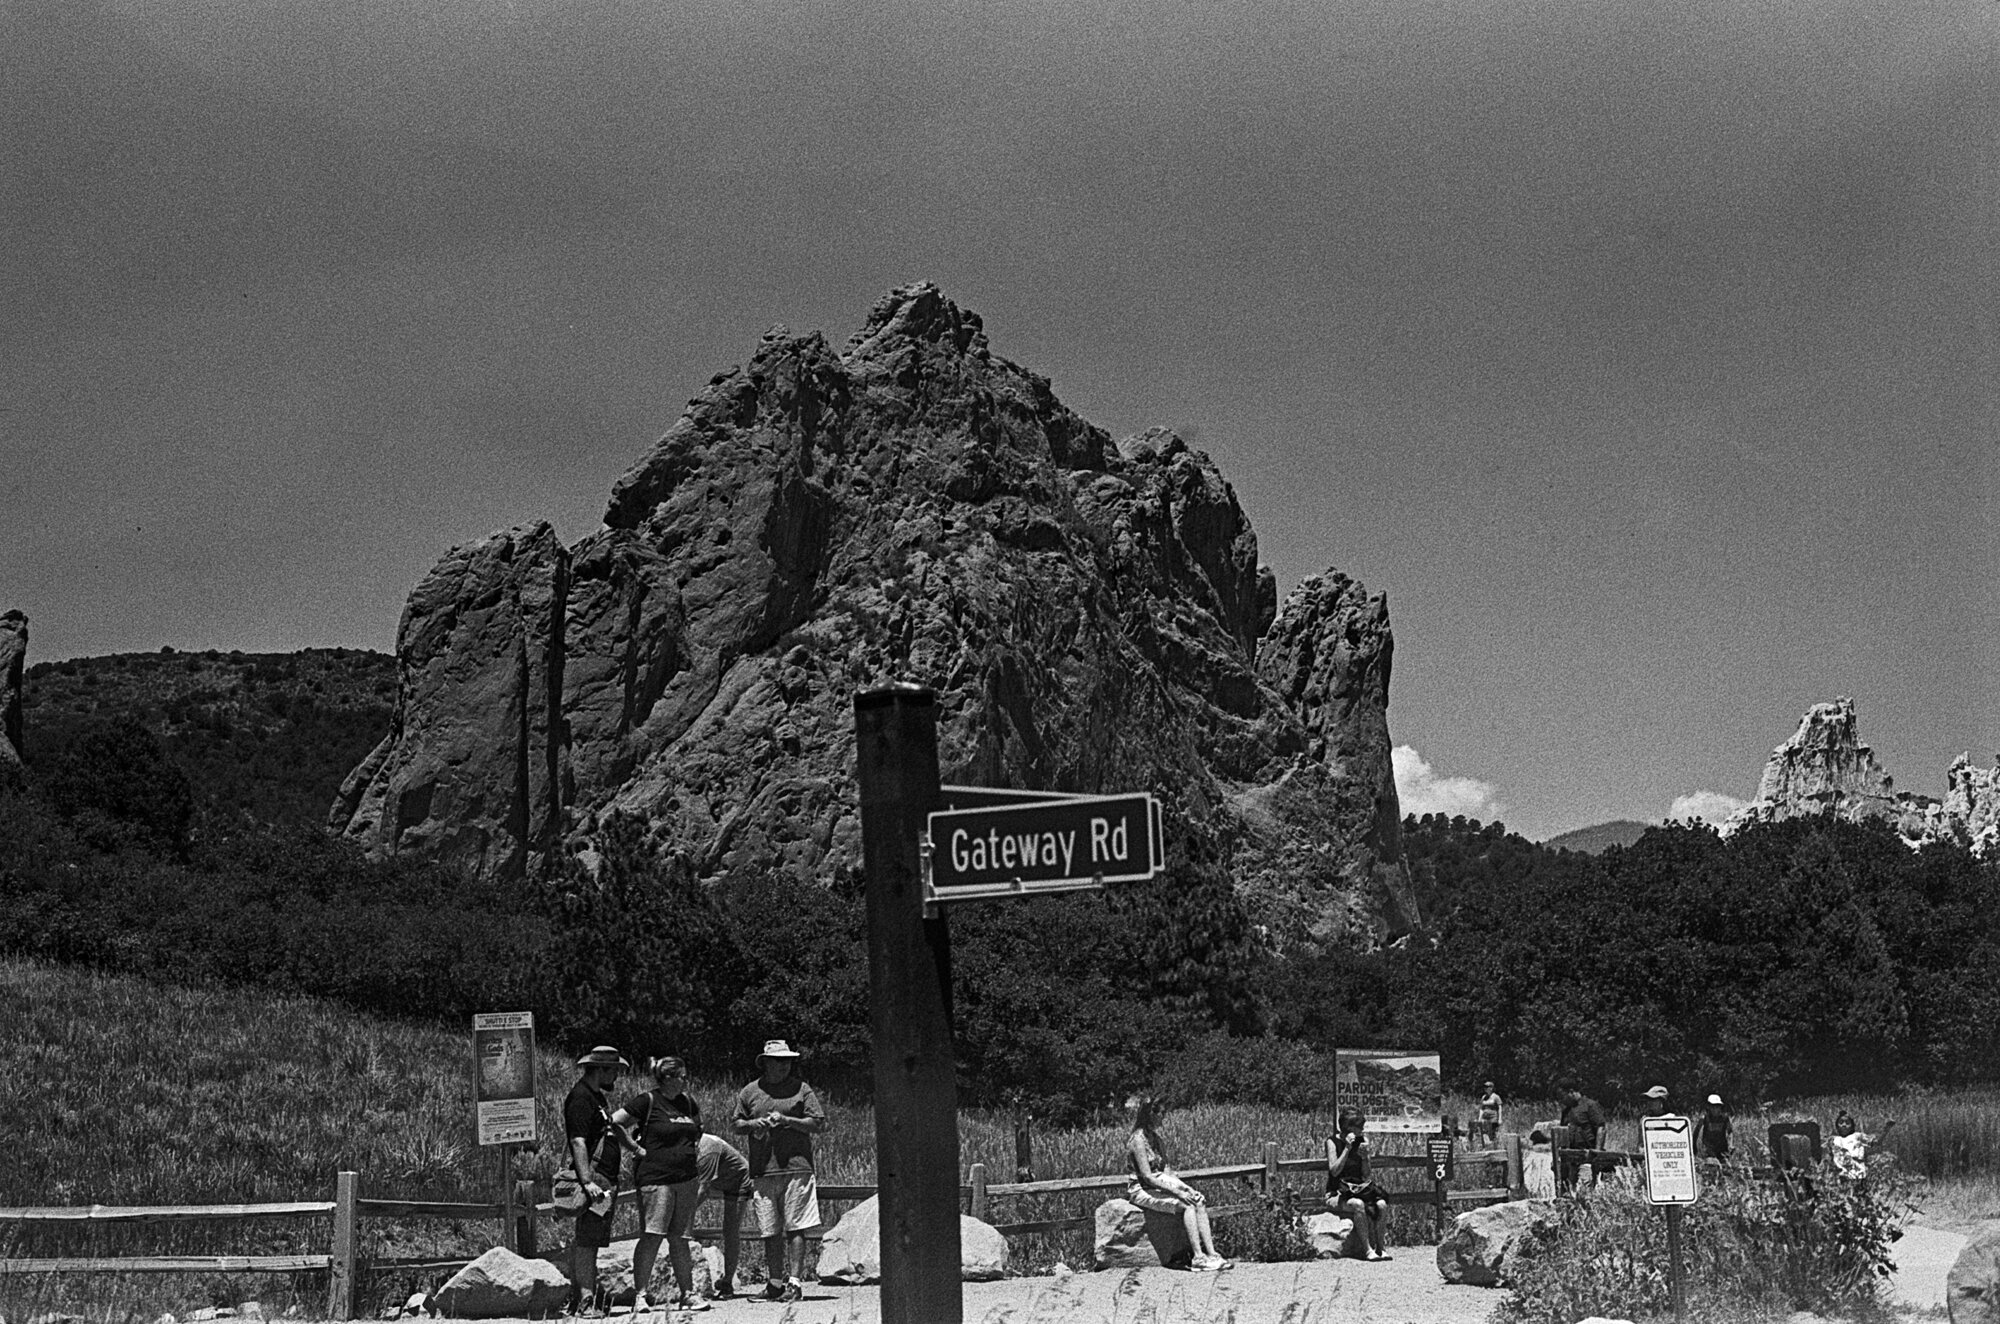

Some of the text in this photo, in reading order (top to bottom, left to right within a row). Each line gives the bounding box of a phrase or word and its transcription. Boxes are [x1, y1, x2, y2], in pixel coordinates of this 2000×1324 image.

[951, 816, 1128, 877] Gateway Rd
[508, 1016, 522, 1024] STOP
[1338, 1082, 1384, 1095] PARDON
[1338, 1095, 1388, 1106] OUR DUST
[1655, 1151, 1684, 1159] VEHICLES
[1662, 1161, 1678, 1169] ONLY
